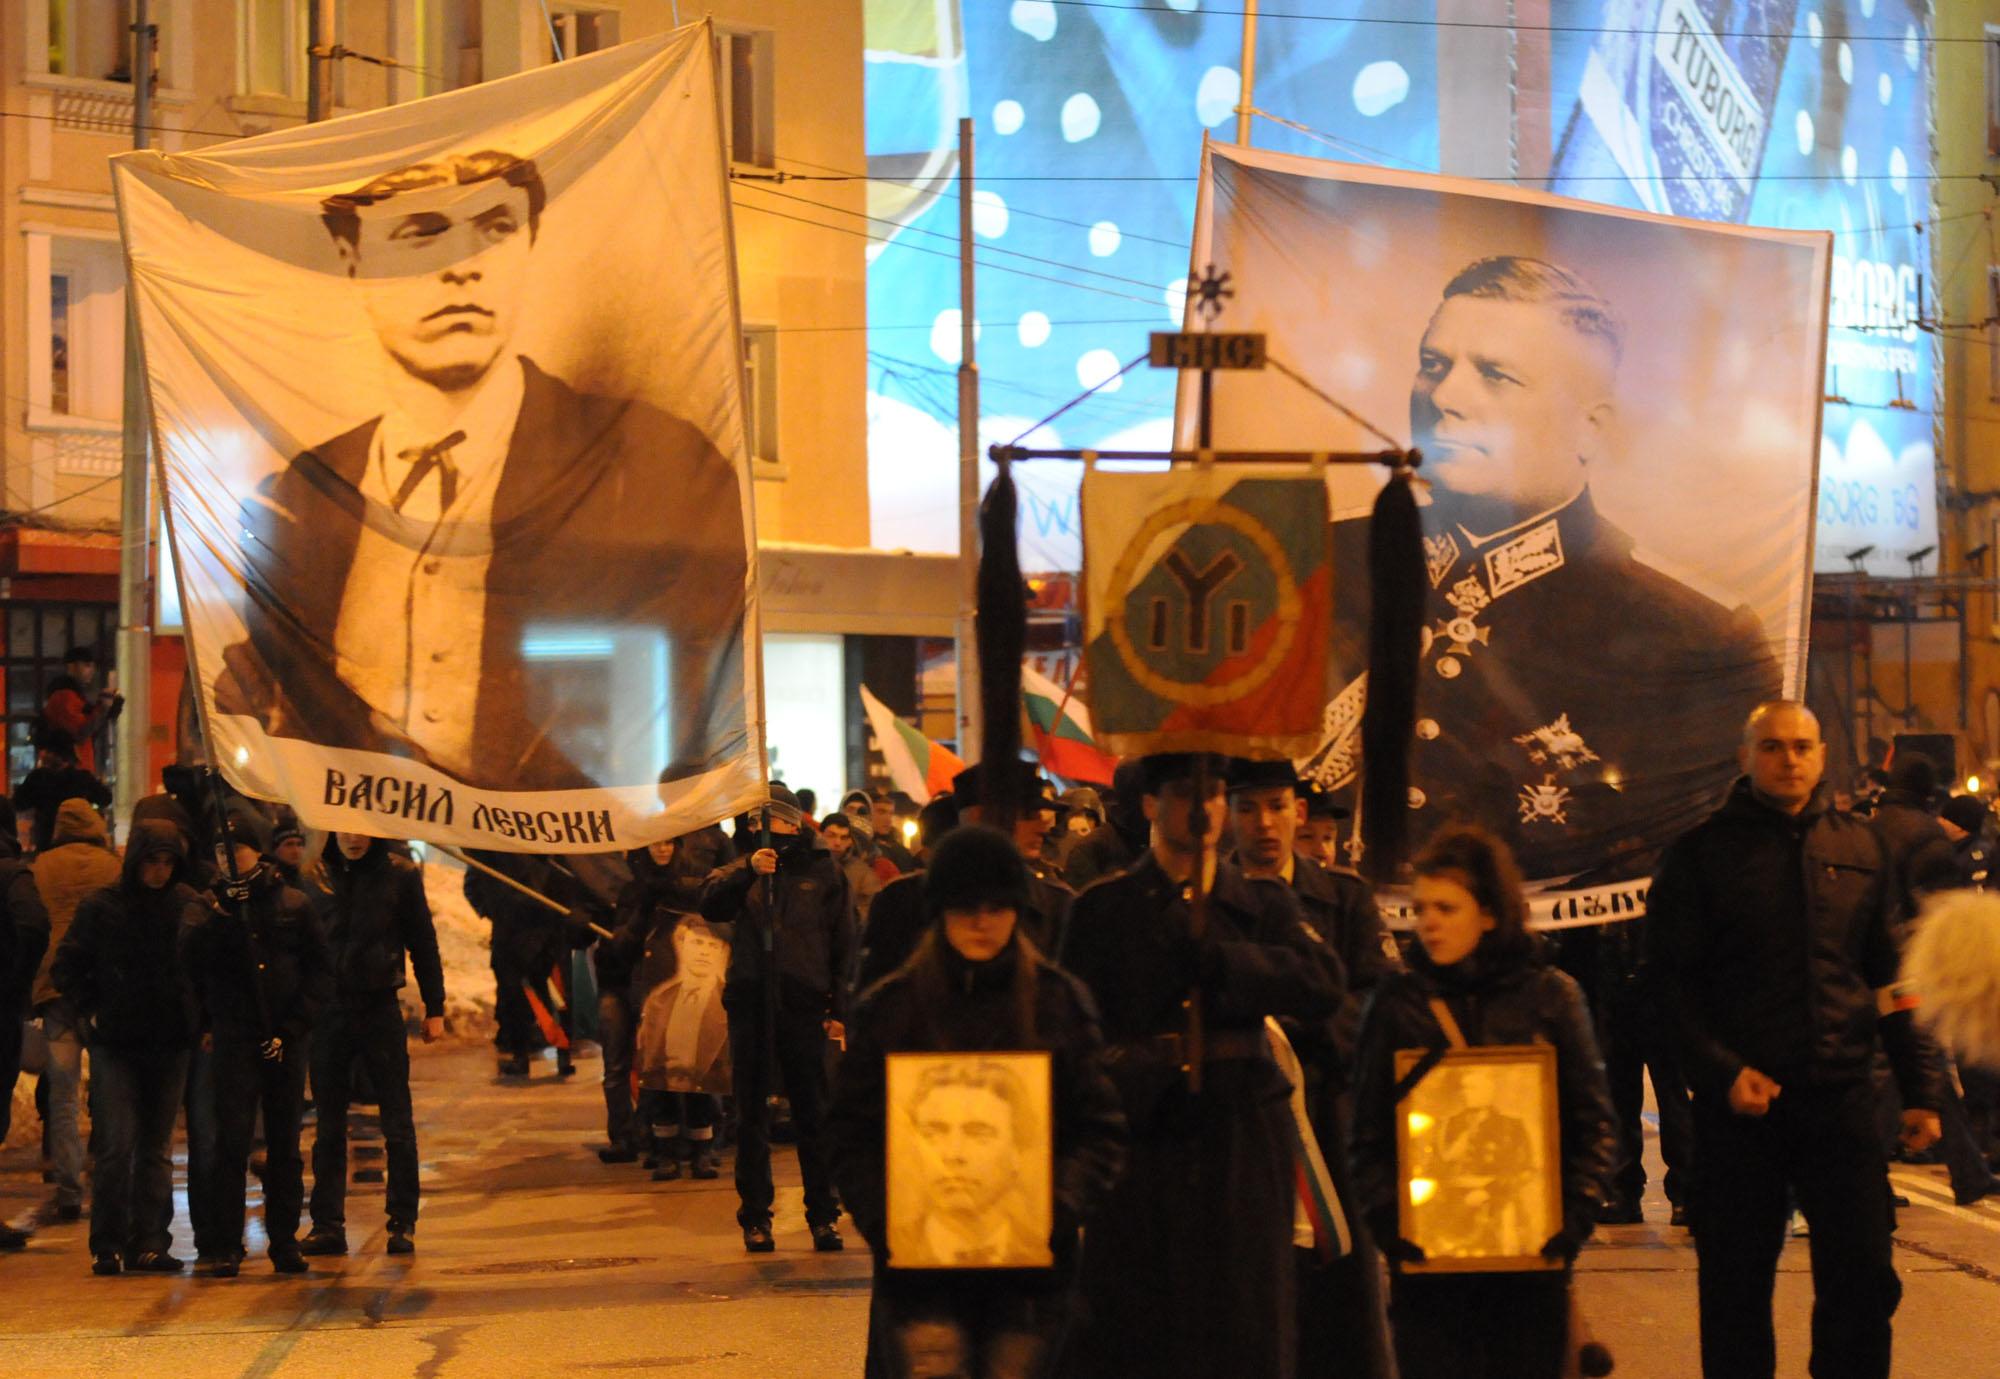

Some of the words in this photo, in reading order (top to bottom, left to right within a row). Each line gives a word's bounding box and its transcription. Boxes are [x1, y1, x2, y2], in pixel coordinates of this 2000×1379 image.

[1671, 10, 1758, 170] TUBORG
[1830, 257, 1919, 343] BORG
[323, 768, 454, 826] ВАСИЛ
[472, 801, 616, 844] ЛЕВСКИ
